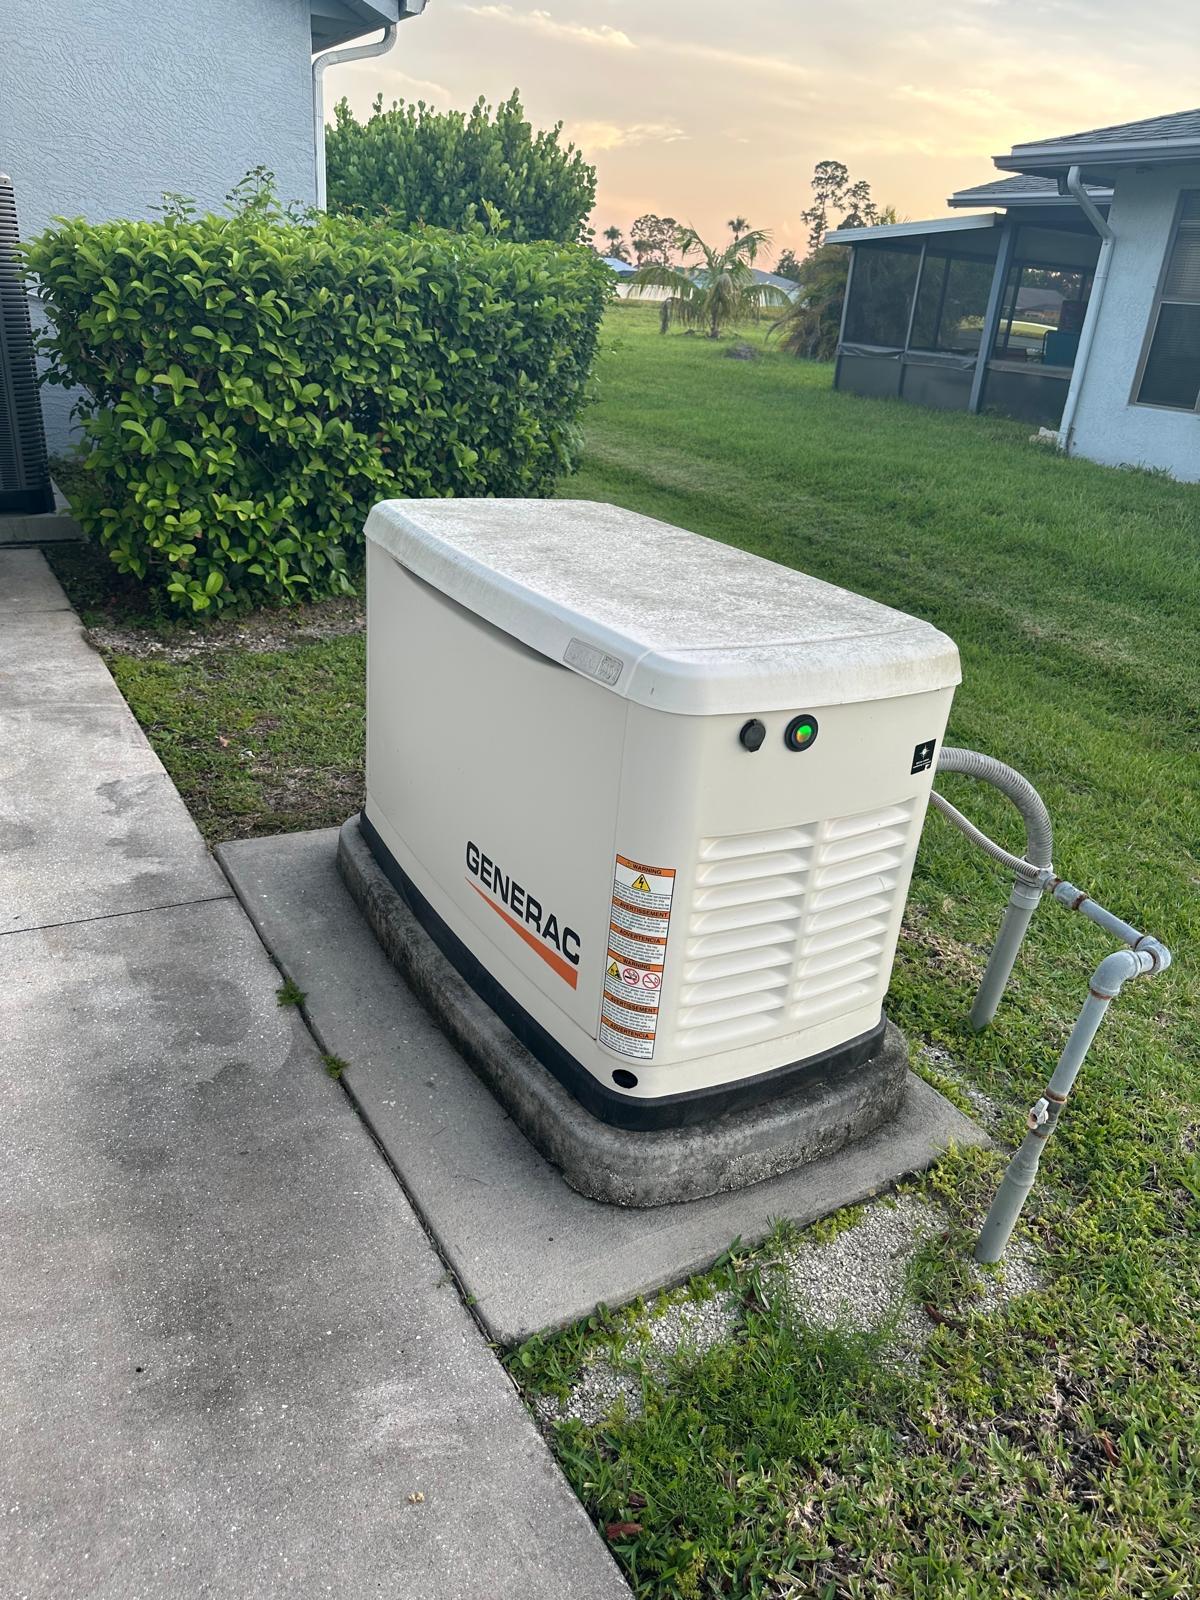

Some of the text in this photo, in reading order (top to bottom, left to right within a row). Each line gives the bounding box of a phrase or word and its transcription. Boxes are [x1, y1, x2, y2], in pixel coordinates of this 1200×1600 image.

[632, 863, 662, 875] WARNING
[466, 840, 581, 966] GENERAC
[620, 901, 668, 918] AVERTISSEMENT
[619, 929, 661, 944] ADVERTENCIA
[622, 957, 651, 970] WARNING
[610, 996, 657, 1013] AVERTISSEMENT
[609, 1022, 650, 1039] ADVERTENCIA
